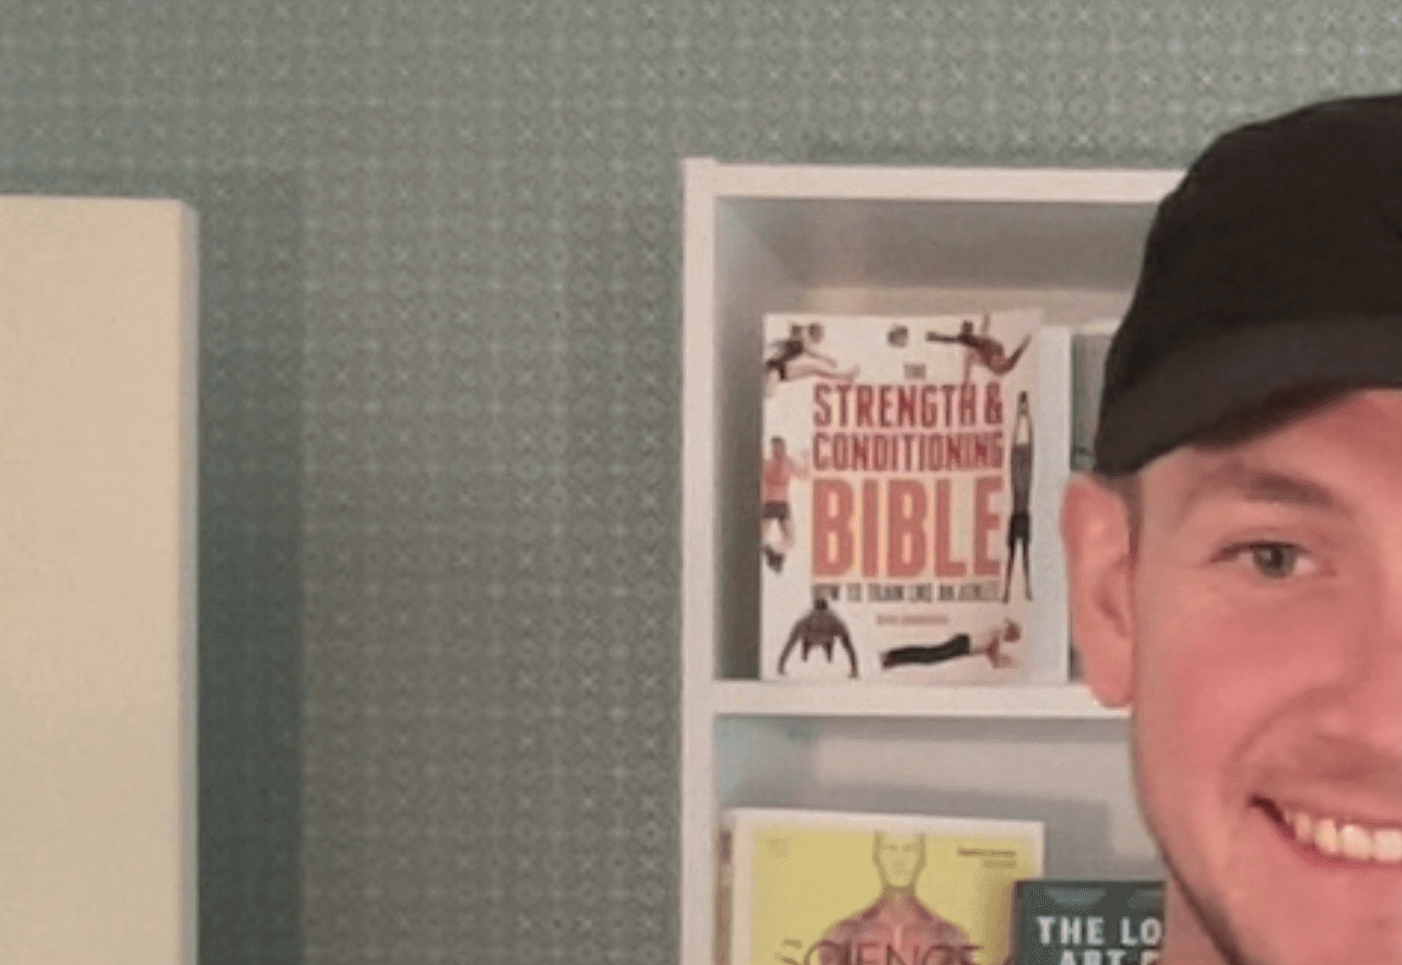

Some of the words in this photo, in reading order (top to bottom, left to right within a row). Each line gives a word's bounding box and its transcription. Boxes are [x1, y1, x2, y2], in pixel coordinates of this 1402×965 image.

[814, 384, 976, 427] STRENGTH
[984, 382, 1003, 424] &
[813, 432, 1003, 471] CONDITIONING
[813, 478, 1001, 578] BIBLE
[1037, 916, 1104, 946] THE
[1120, 916, 1162, 946] LO
